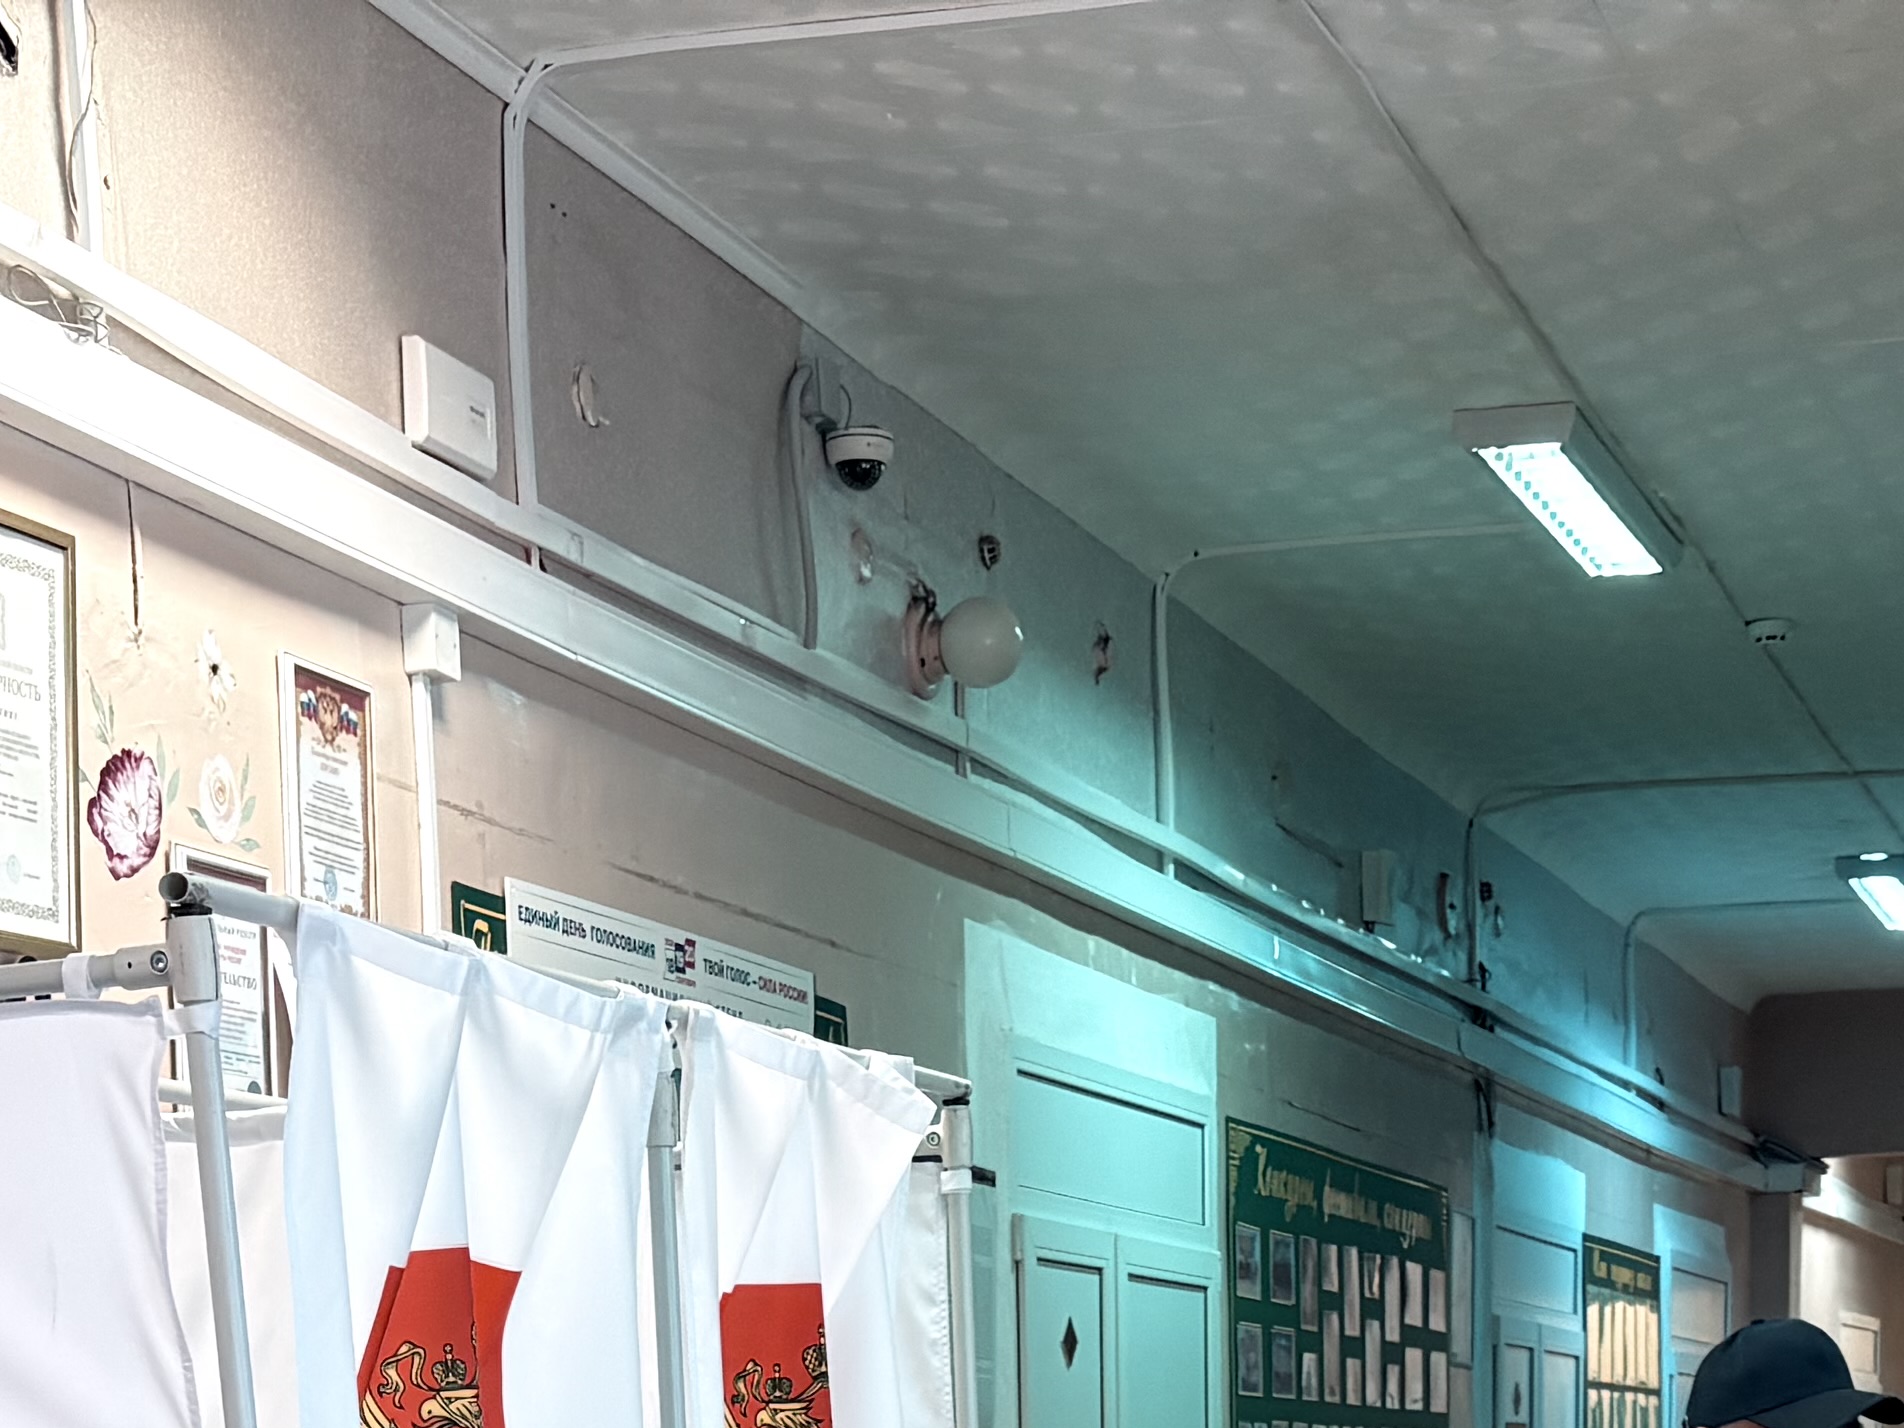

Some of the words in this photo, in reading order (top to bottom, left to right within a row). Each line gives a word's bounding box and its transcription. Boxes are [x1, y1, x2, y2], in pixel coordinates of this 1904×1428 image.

[517, 904, 561, 933] ЕДИНЫЙ
[561, 917, 588, 940] ДЕНЬ
[590, 924, 657, 960] ГОЛОСОВАНИЯ
[703, 954, 725, 979] ТВОЙ
[725, 964, 751, 988] ГОЛОС
